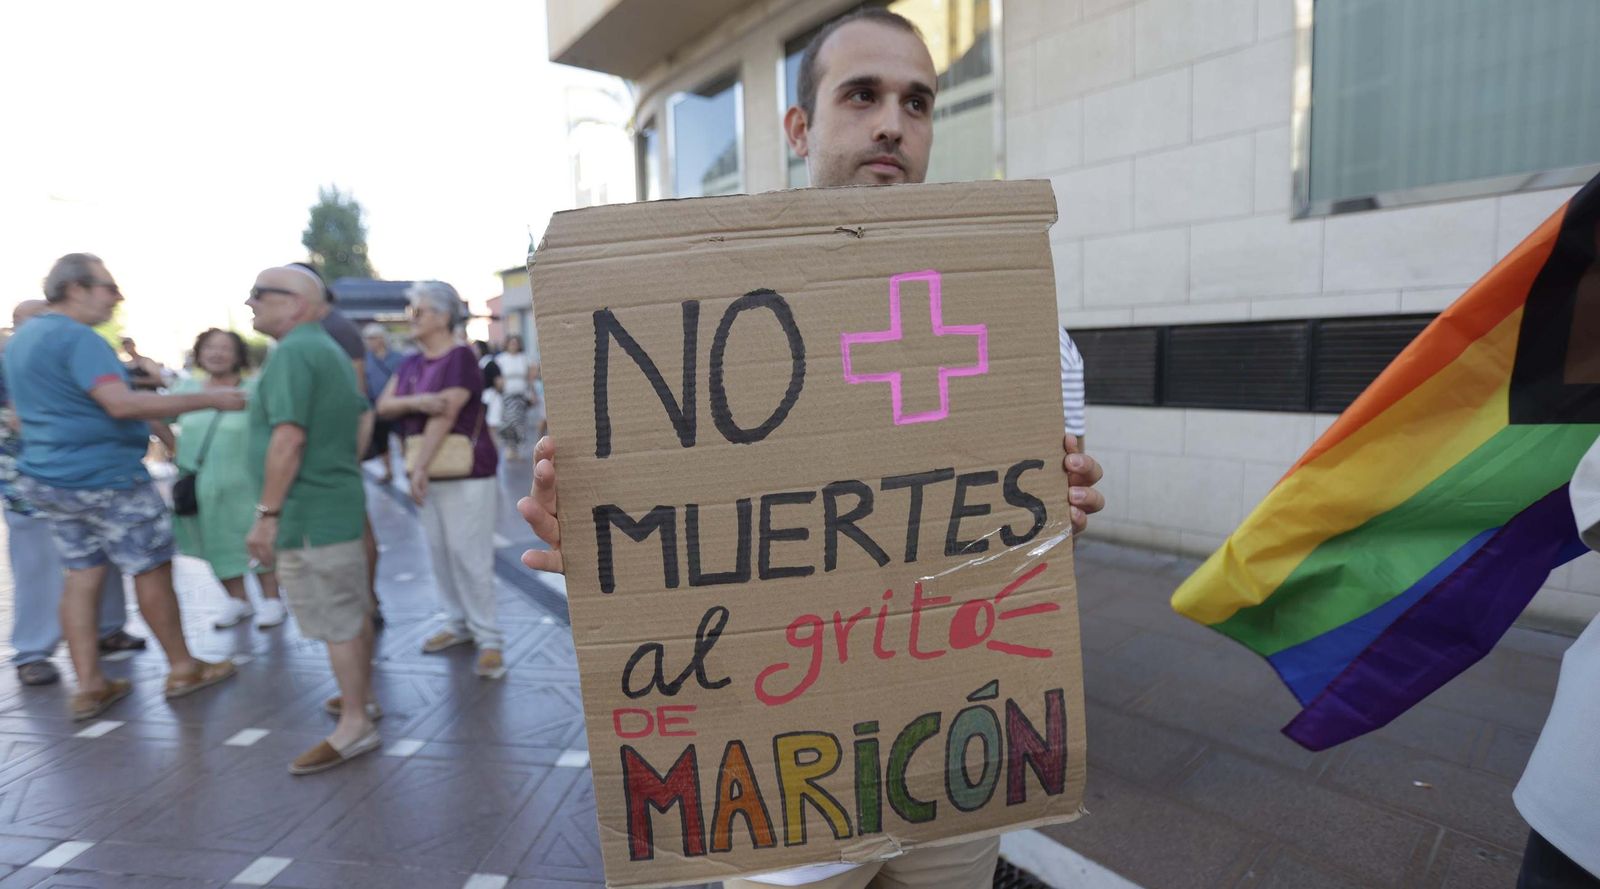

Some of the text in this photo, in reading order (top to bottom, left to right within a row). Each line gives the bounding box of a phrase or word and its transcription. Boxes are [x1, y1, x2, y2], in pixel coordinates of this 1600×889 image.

[593, 288, 806, 459] NO
[592, 458, 1048, 594] MUERTES
[621, 582, 996, 706] al grito
[612, 704, 698, 739] DE
